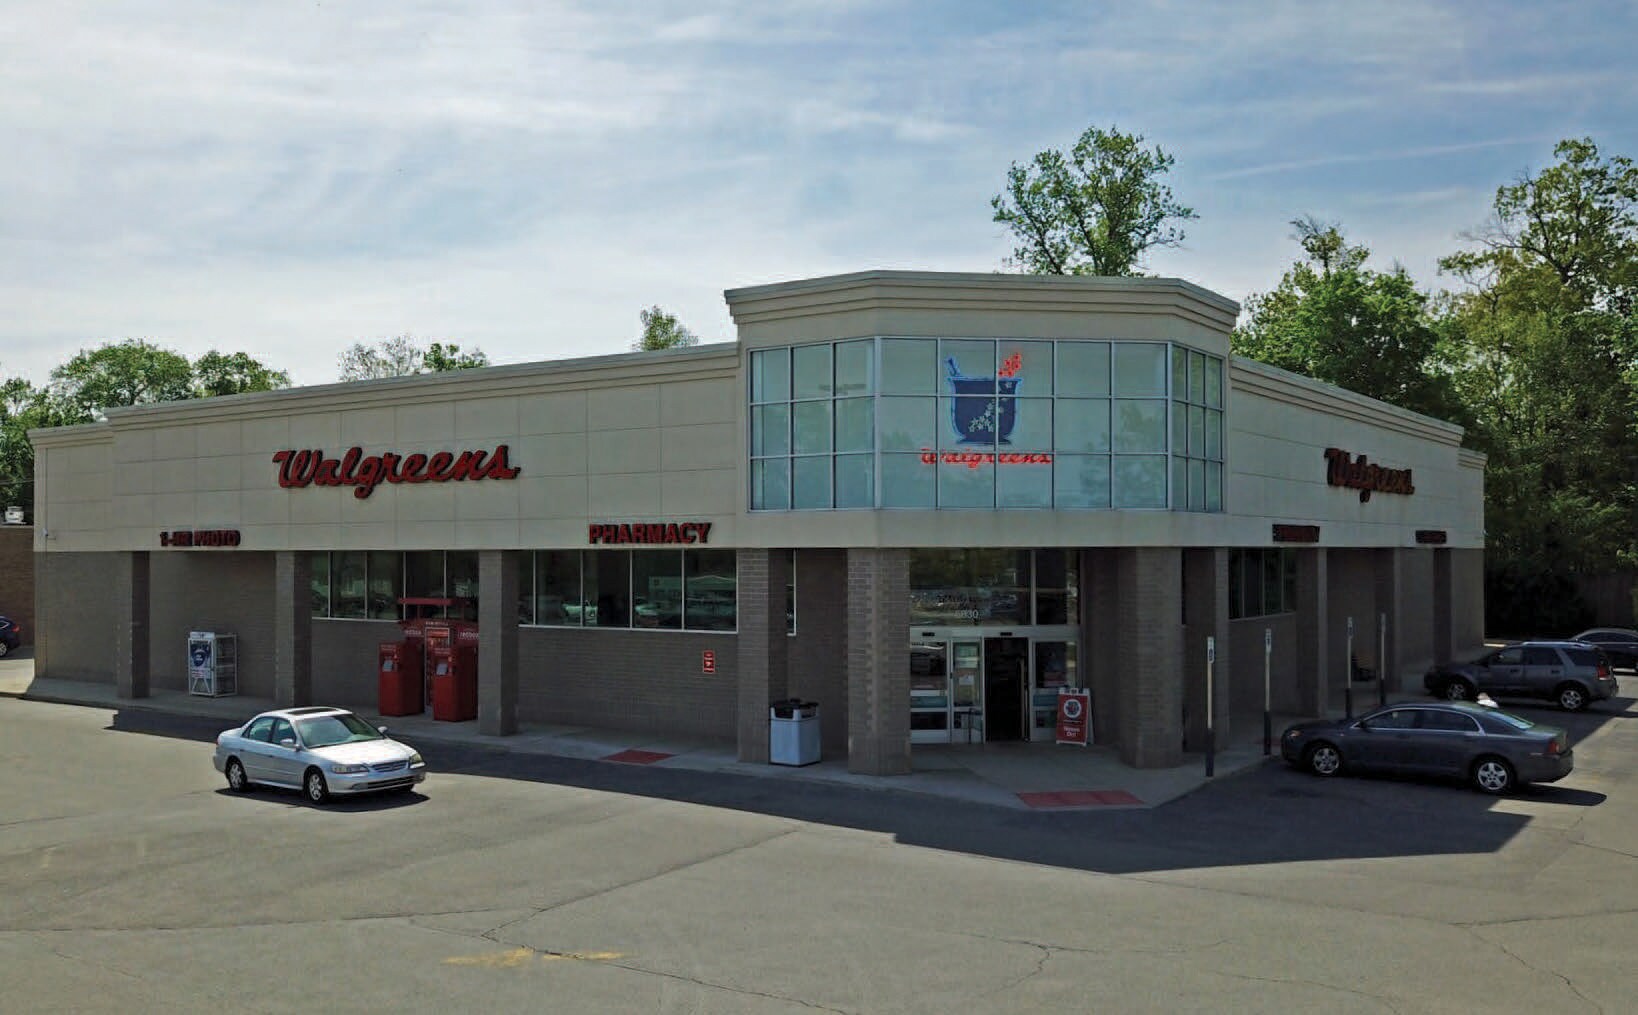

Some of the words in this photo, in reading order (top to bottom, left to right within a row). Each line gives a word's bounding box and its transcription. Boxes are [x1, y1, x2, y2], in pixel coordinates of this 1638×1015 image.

[272, 445, 521, 500] Walgreens
[921, 448, 1052, 468] Walgreens
[1324, 448, 1415, 503] Walgreens
[589, 522, 712, 544] PHARMACY
